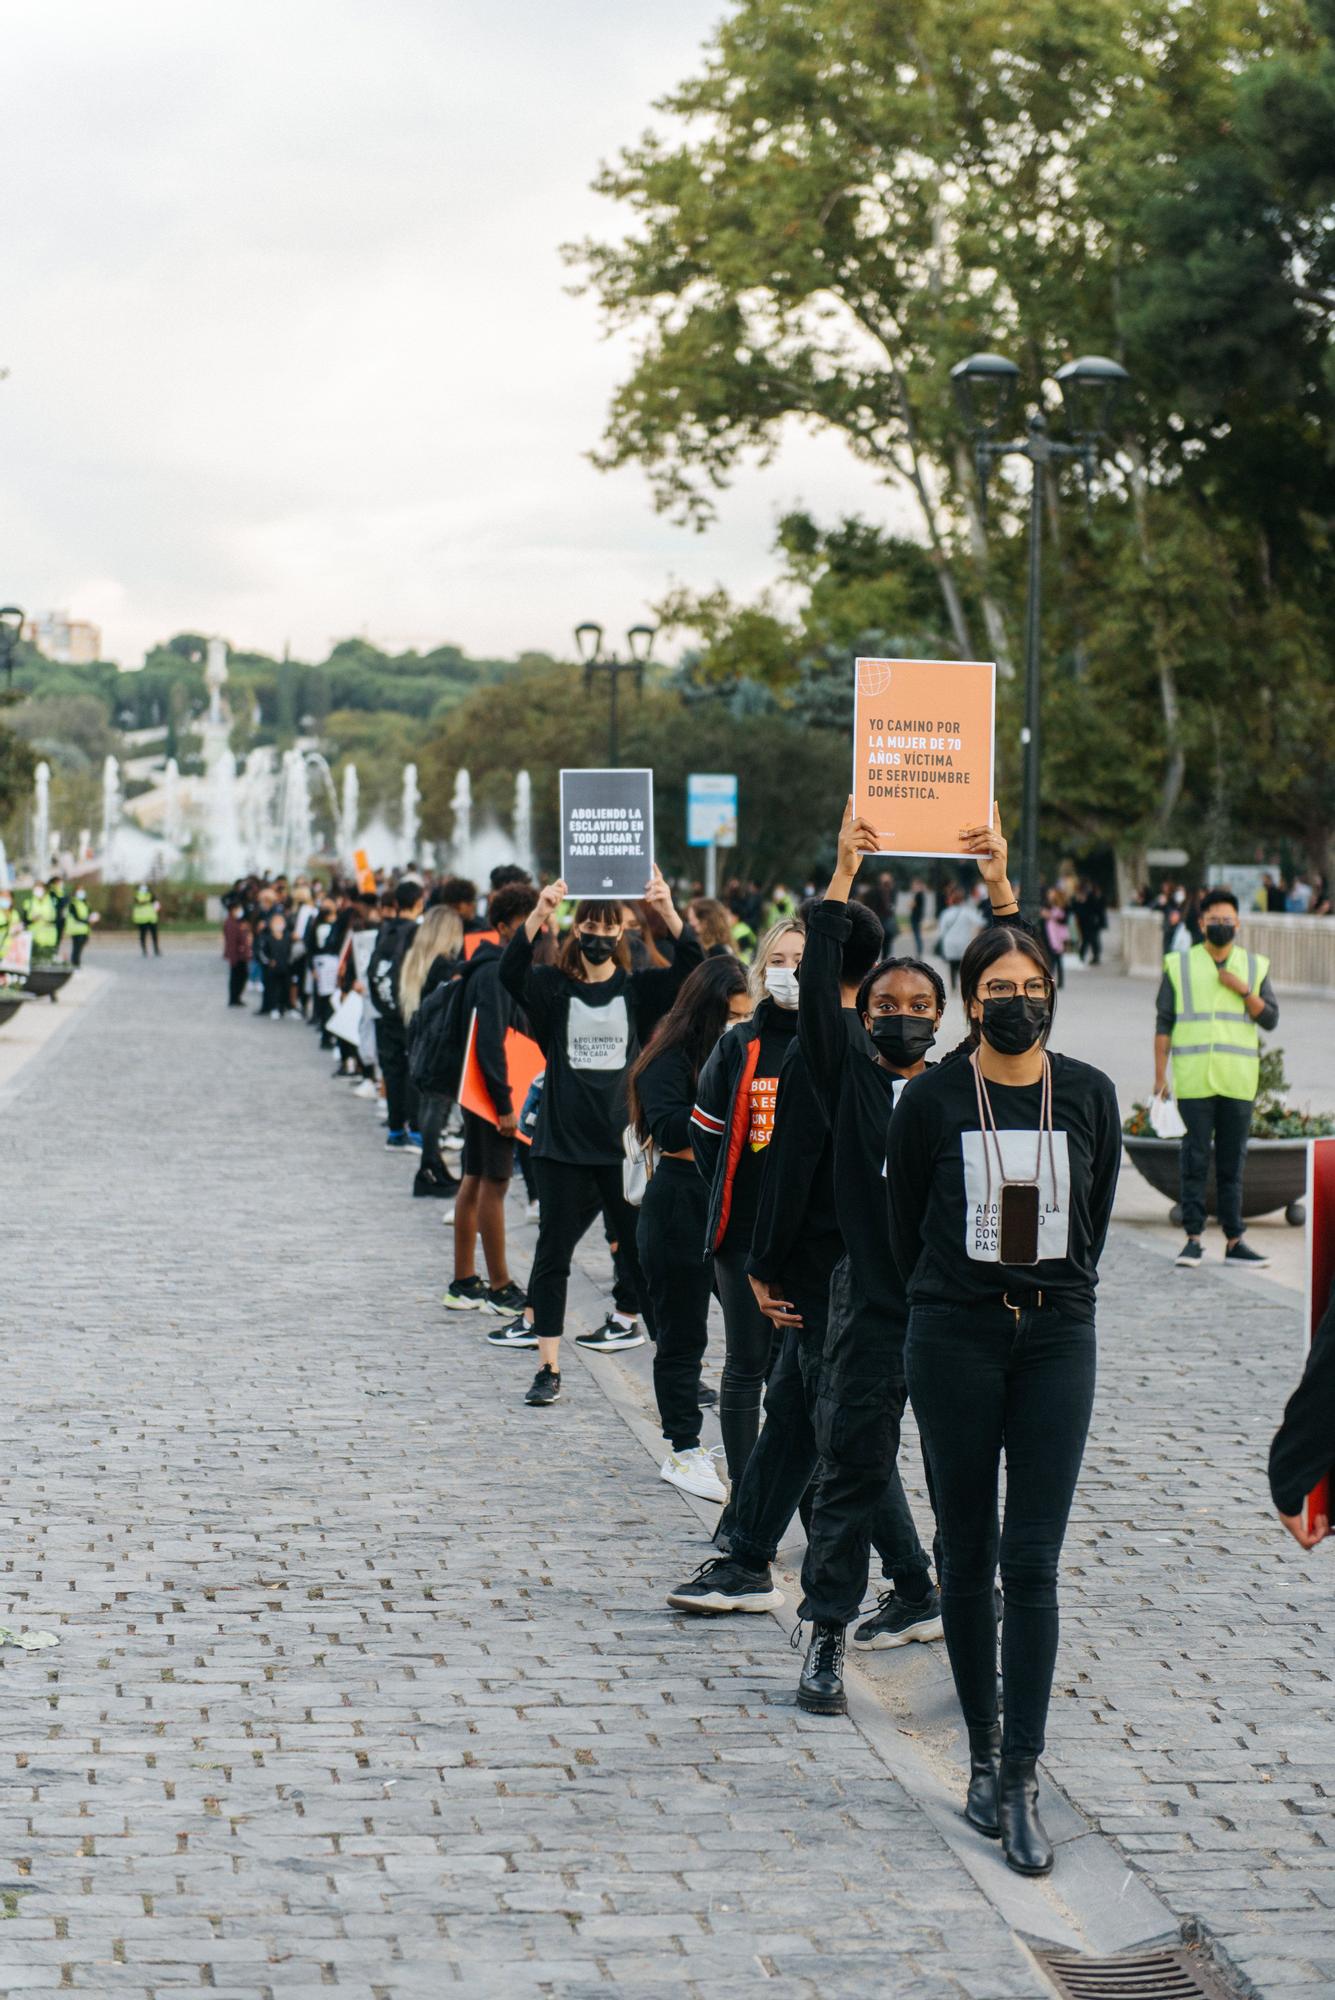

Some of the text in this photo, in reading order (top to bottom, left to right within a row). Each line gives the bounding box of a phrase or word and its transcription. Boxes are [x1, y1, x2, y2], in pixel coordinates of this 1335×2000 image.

[869, 718, 960, 734] YO CAMINO POR
[868, 735, 961, 751] LA MUJER DE 70
[868, 750, 953, 767] AÑOS VÍCTIMA
[868, 769, 970, 785] DE SERVIDUMBRE
[868, 783, 939, 800] DOMÉSTICA.
[571, 808, 642, 819] ABOLIENDO LA
[569, 820, 644, 832] ESCLAVITUD EN
[572, 833, 642, 844] TODO LUGAR Y
[569, 845, 644, 856] PARA SIEMPRE.
[975, 1228, 998, 1239] CON
